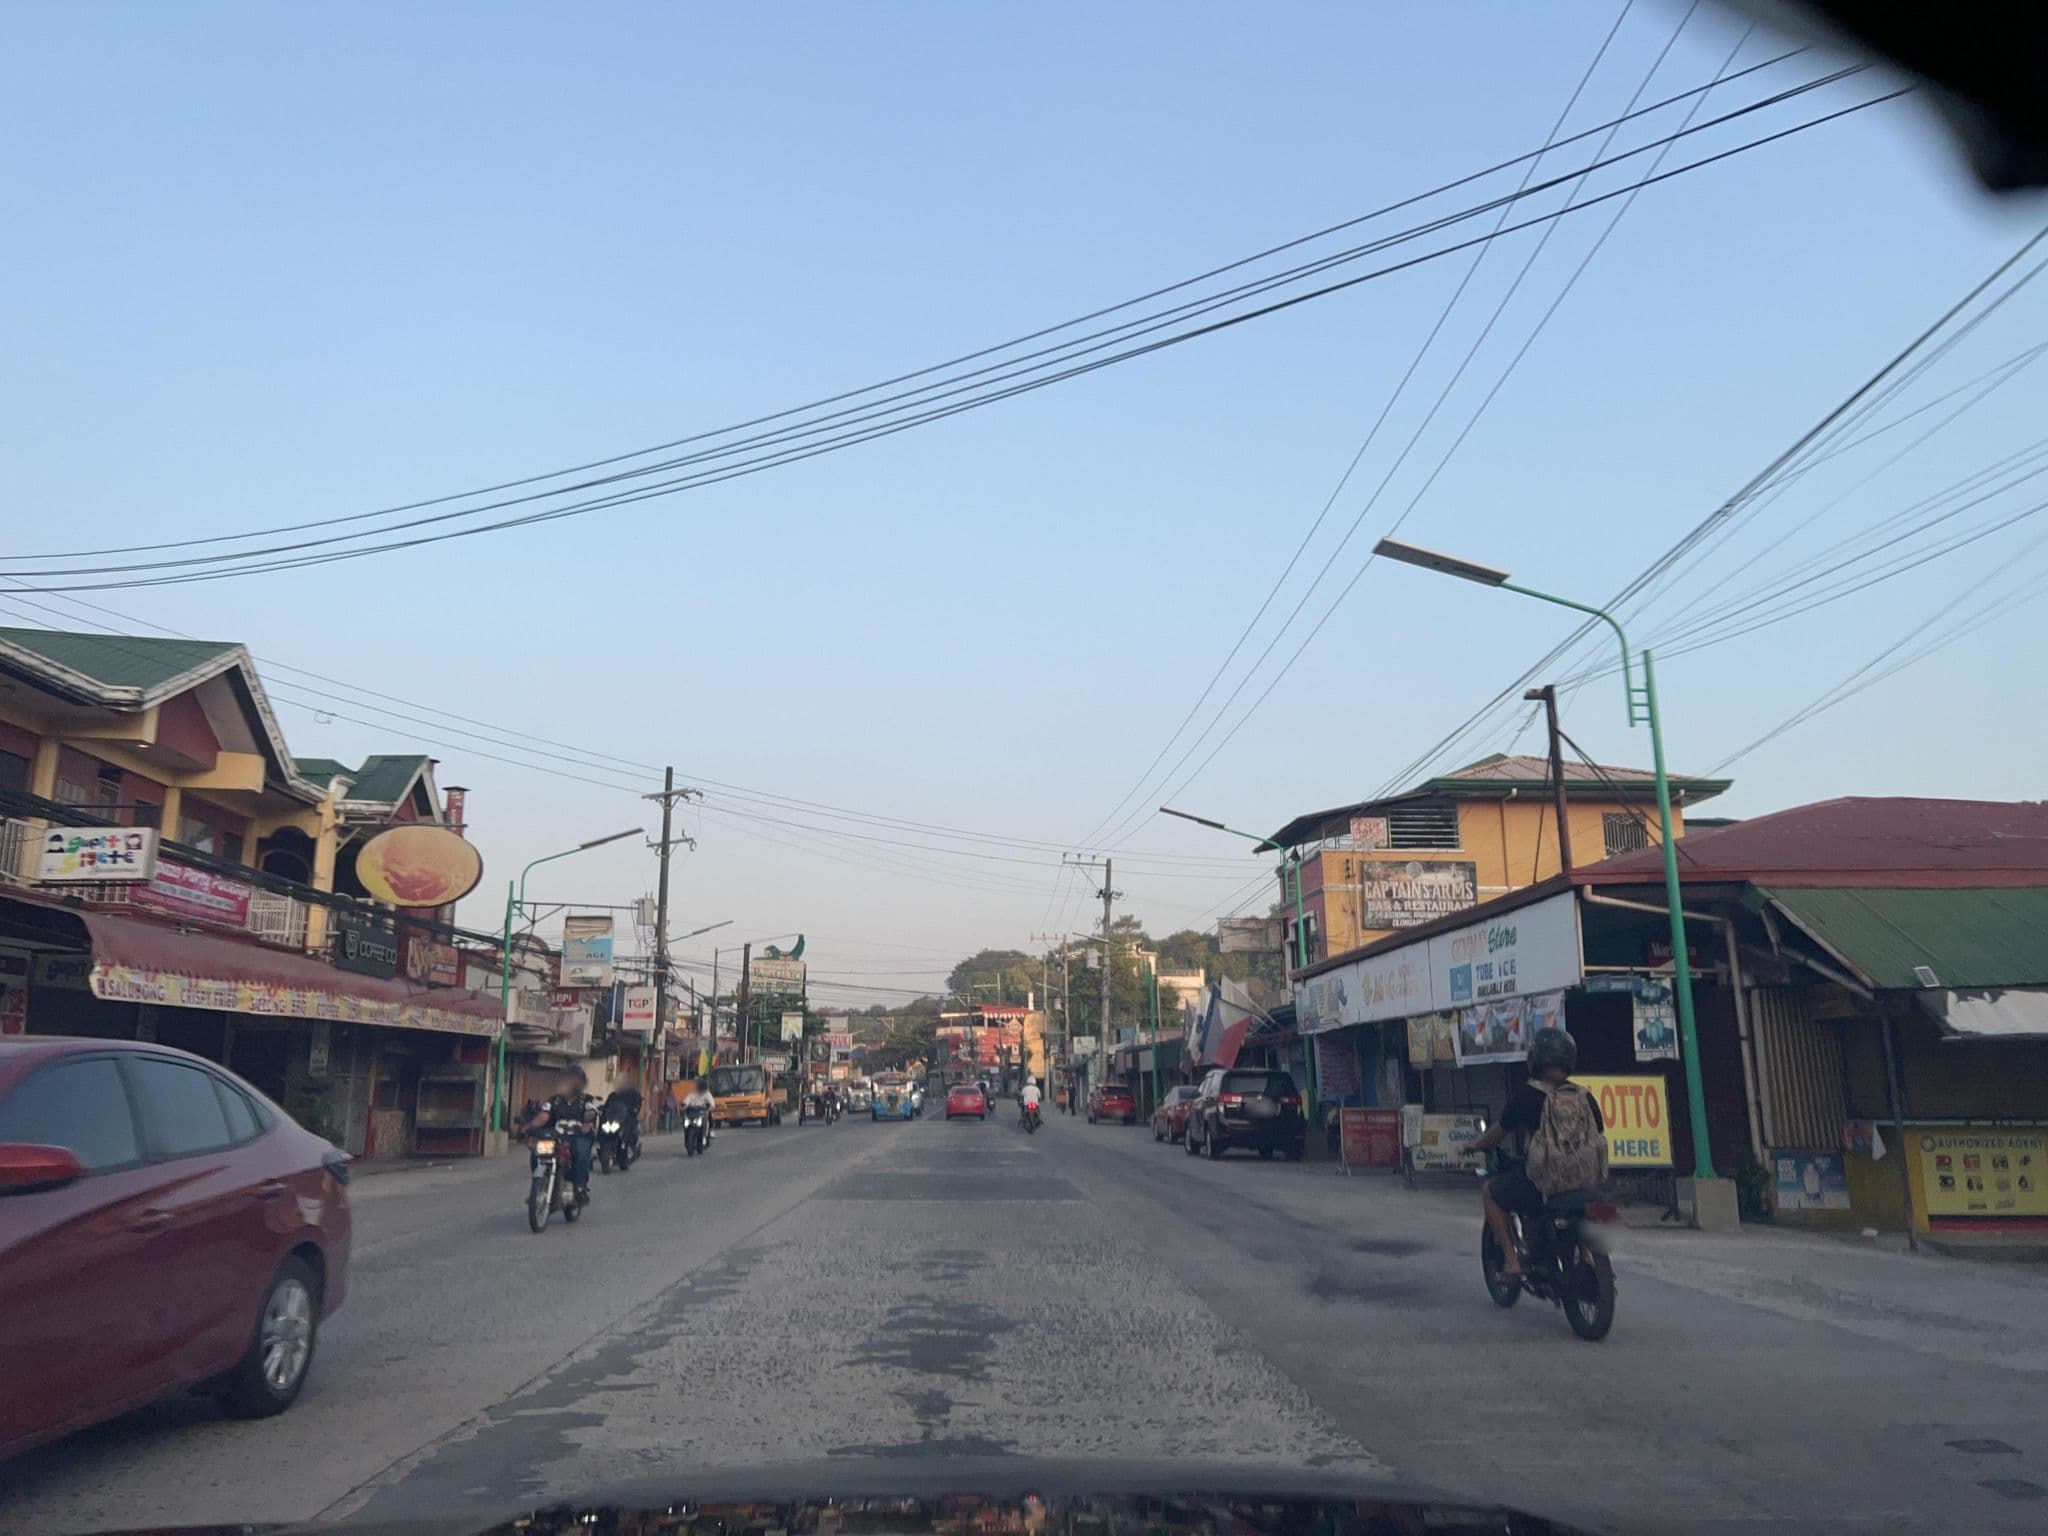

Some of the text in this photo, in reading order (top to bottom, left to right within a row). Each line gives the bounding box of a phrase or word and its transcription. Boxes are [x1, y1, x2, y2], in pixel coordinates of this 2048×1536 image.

[1432, 880, 1474, 900] ARMS
[1367, 900, 1392, 912] BAR
[1487, 925, 1518, 953] Store
[1475, 958, 1517, 982] TUBE ICE
[1503, 978, 1517, 994] HERE
[179, 988, 211, 1005] CRISPY
[556, 992, 573, 1003] BPI
[628, 998, 649, 1010] TGP
[1586, 1083, 1660, 1130] OTTO
[1613, 1138, 1661, 1157] HERE
[1938, 1136, 2044, 1150] AUTHORIZED AGENT
